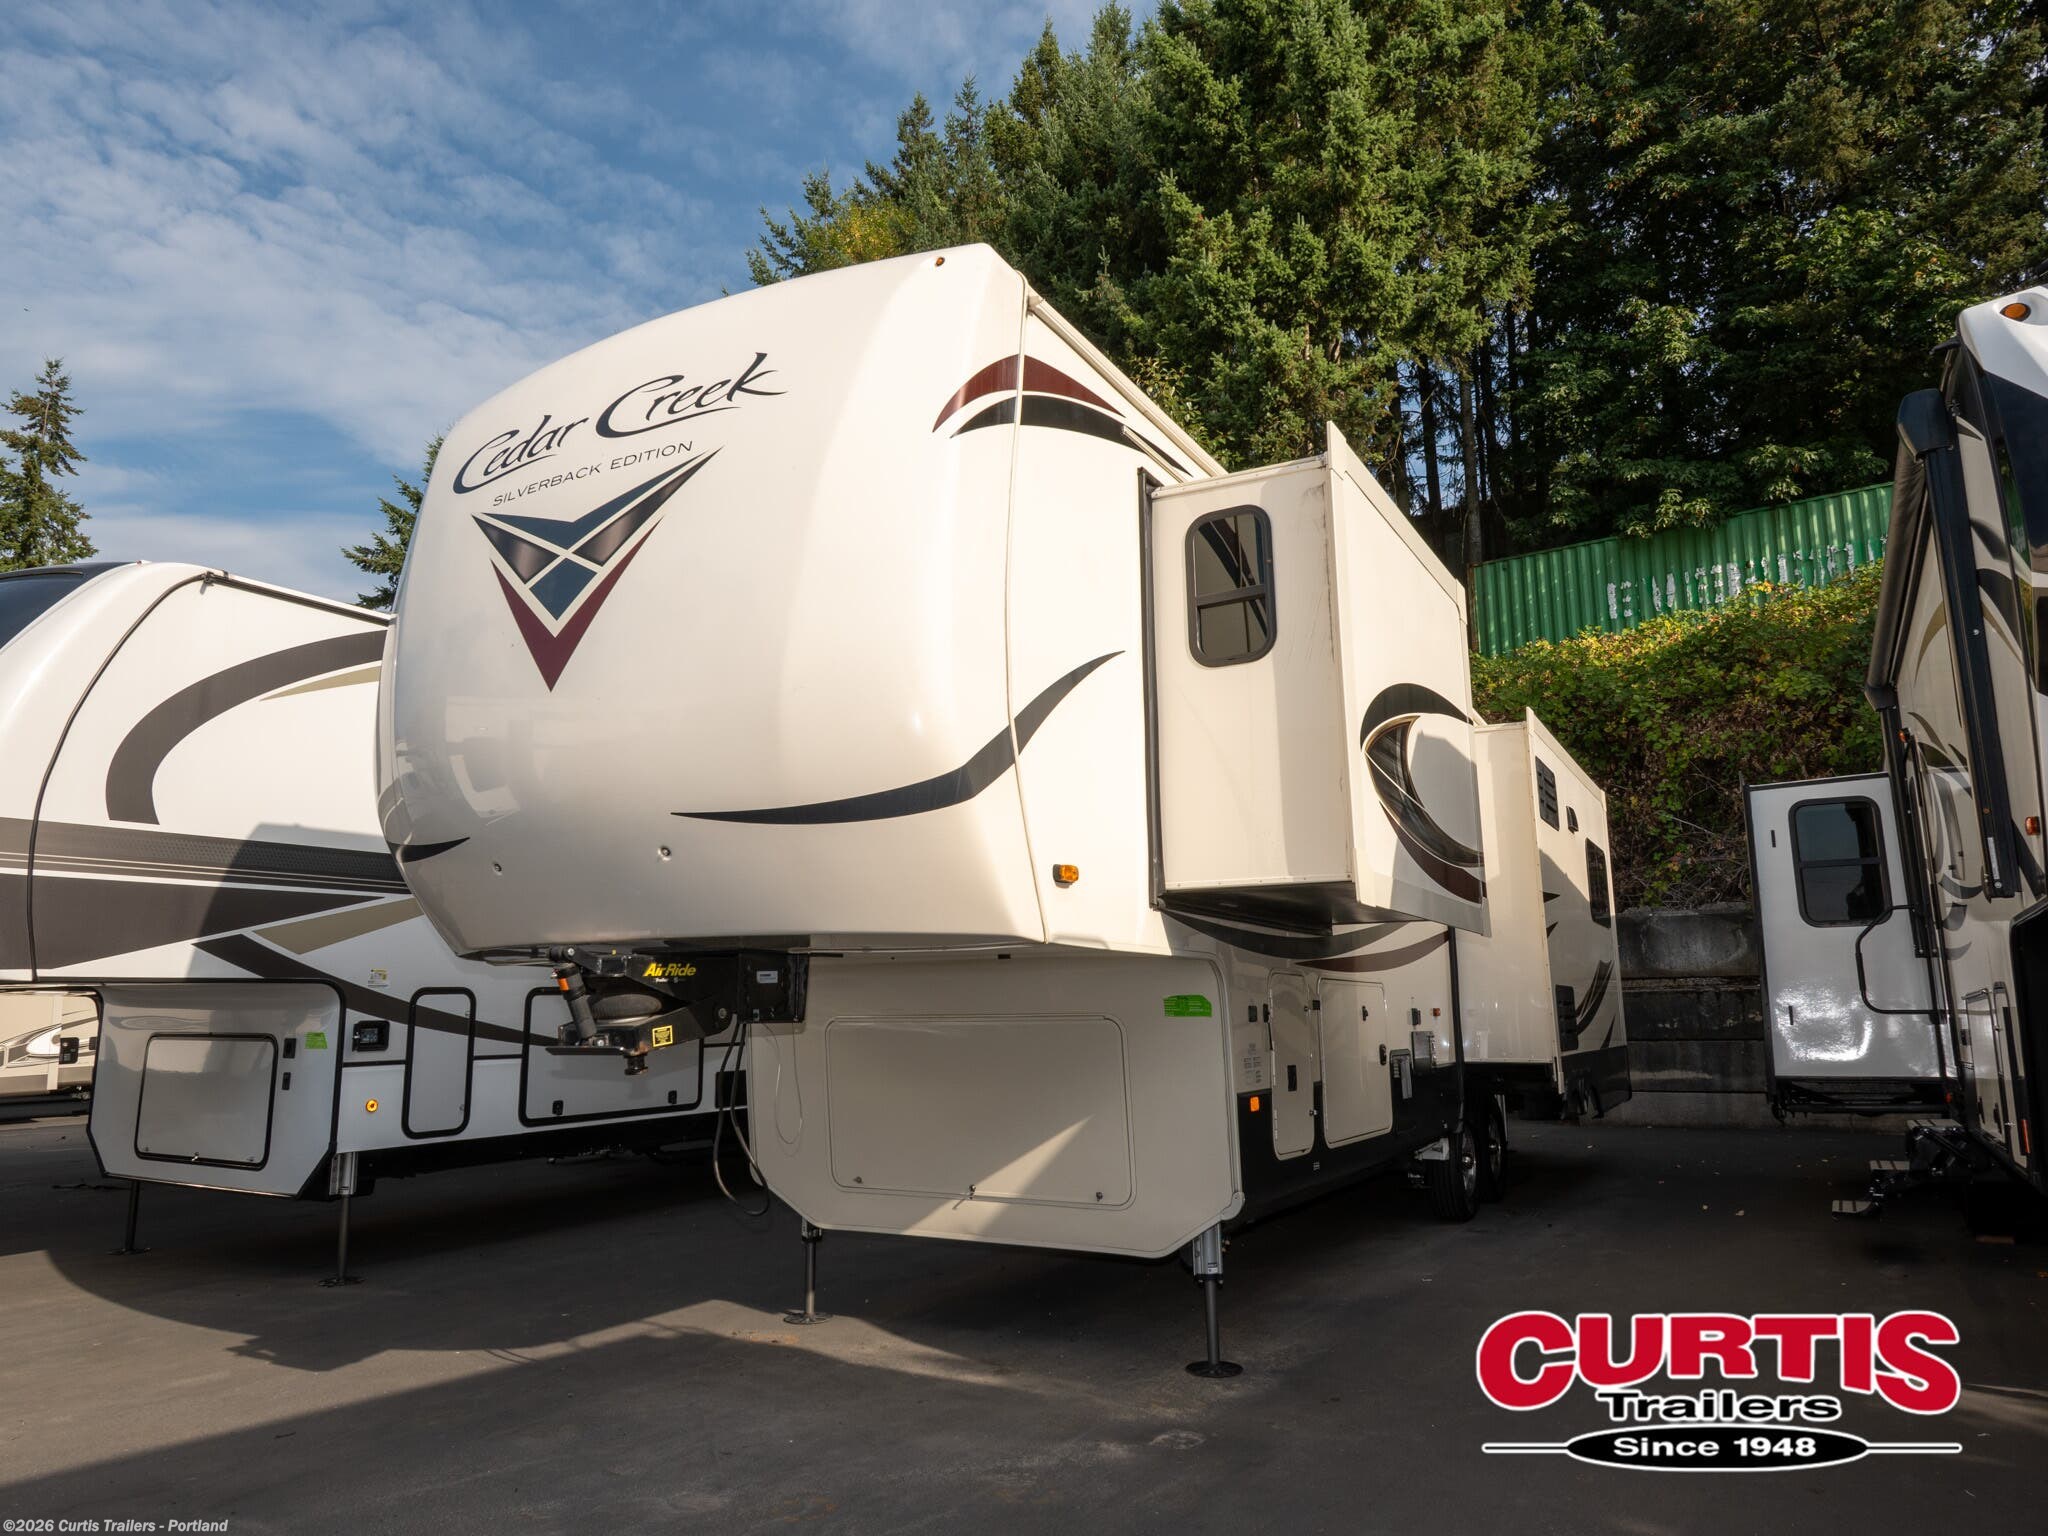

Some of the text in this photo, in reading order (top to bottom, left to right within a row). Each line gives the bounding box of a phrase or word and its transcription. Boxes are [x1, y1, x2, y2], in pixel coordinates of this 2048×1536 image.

[452, 351, 788, 495] Cedar Creek
[492, 440, 694, 507] SILVERBACK EDITION
